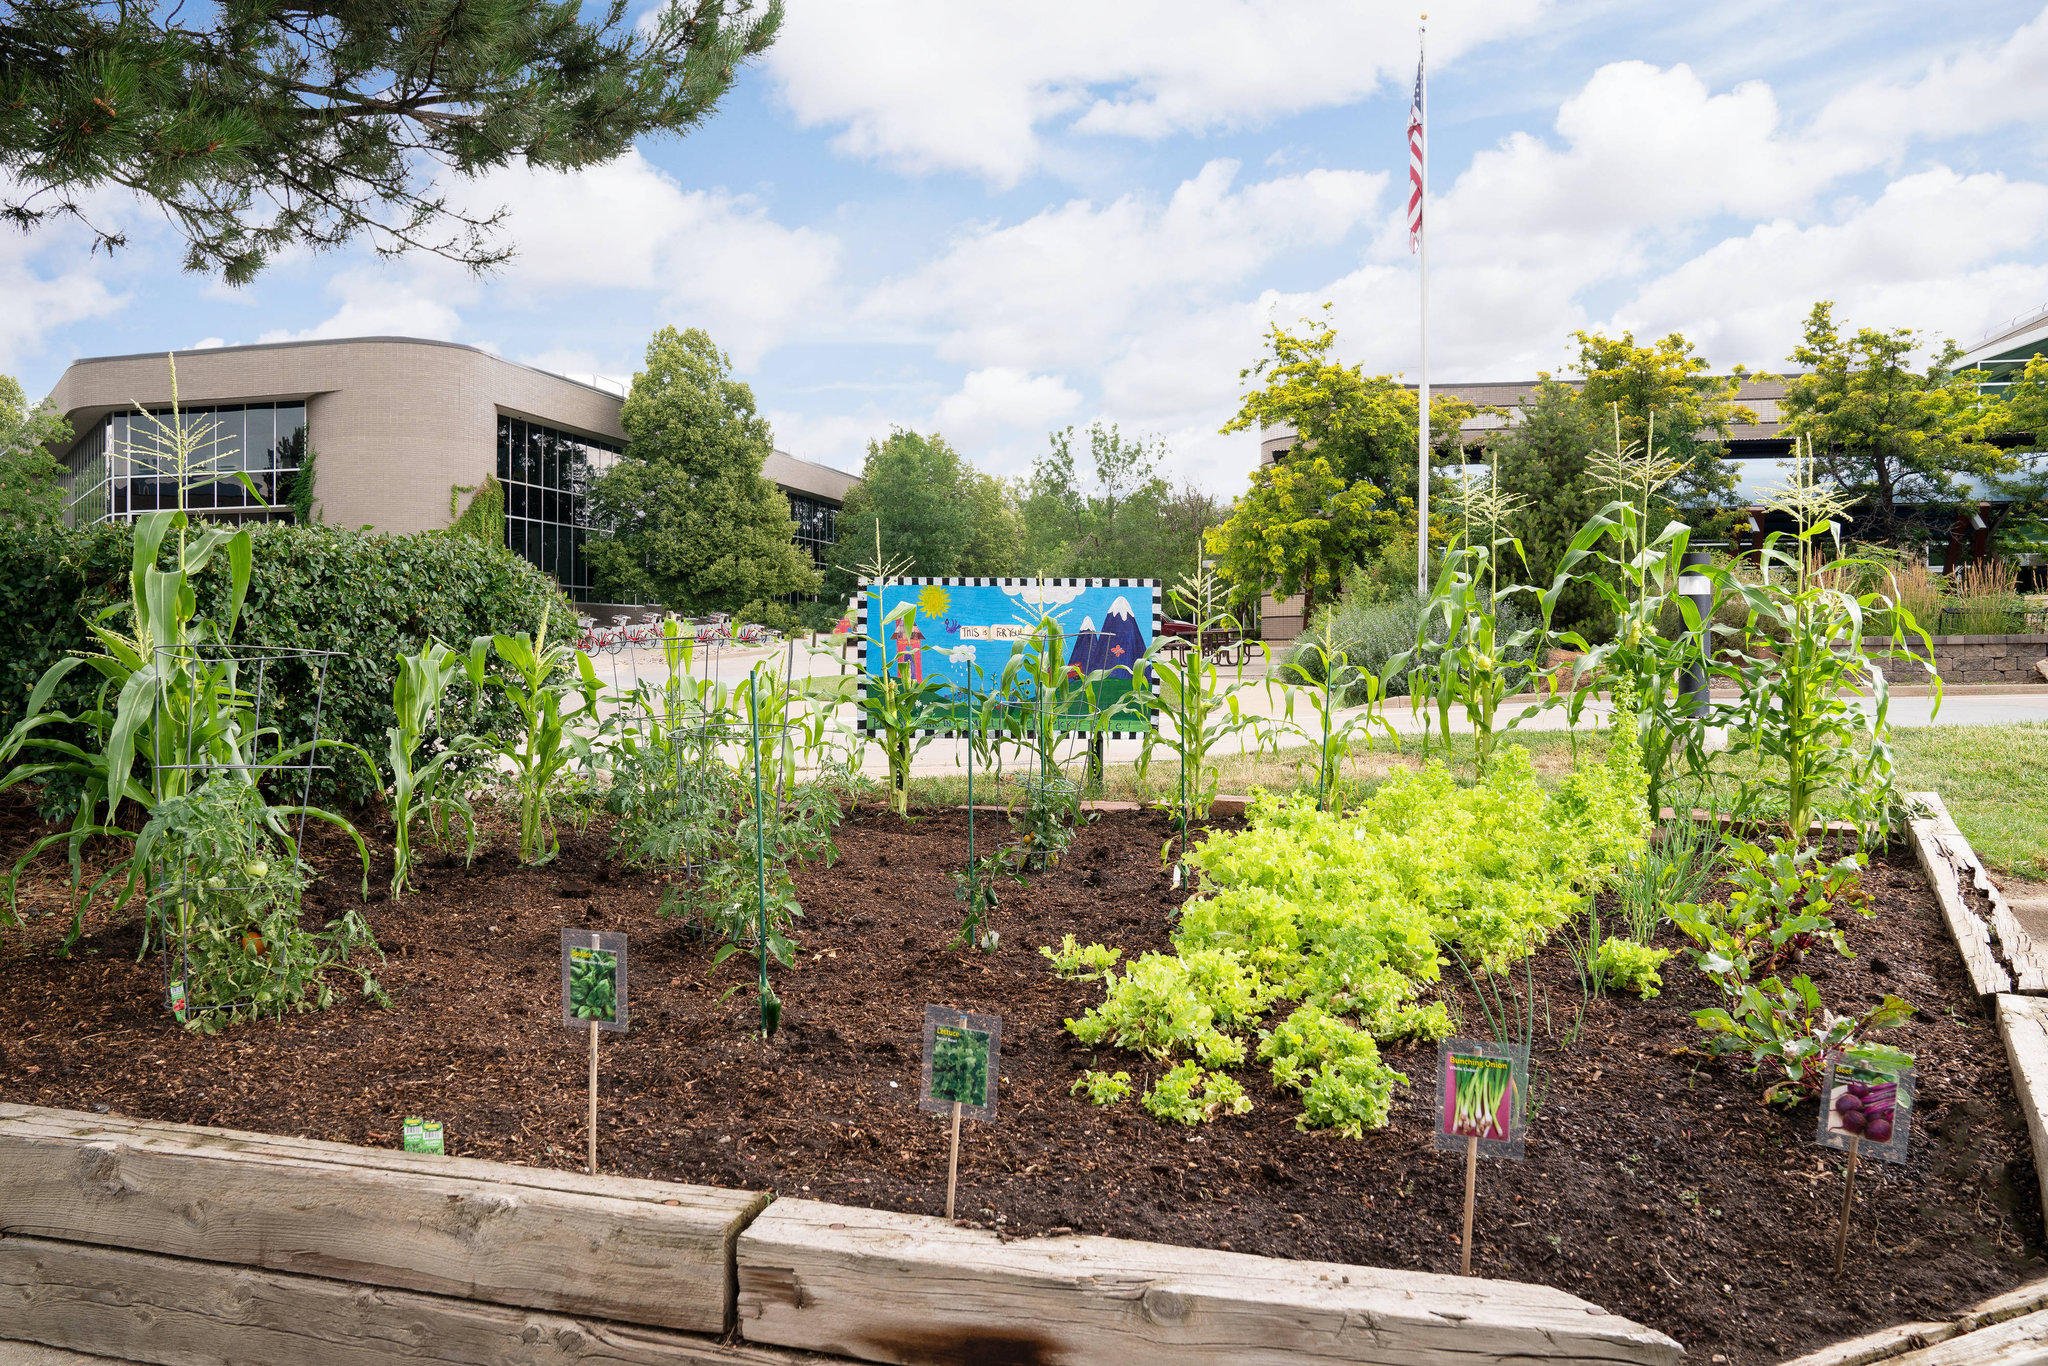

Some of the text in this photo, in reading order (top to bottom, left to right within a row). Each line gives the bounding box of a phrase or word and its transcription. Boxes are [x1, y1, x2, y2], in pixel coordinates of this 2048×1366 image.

[936, 1026, 960, 1037] Lettuce
[1449, 1056, 1508, 1070] Bunching Onion
[1836, 1065, 1853, 1075] Beet
